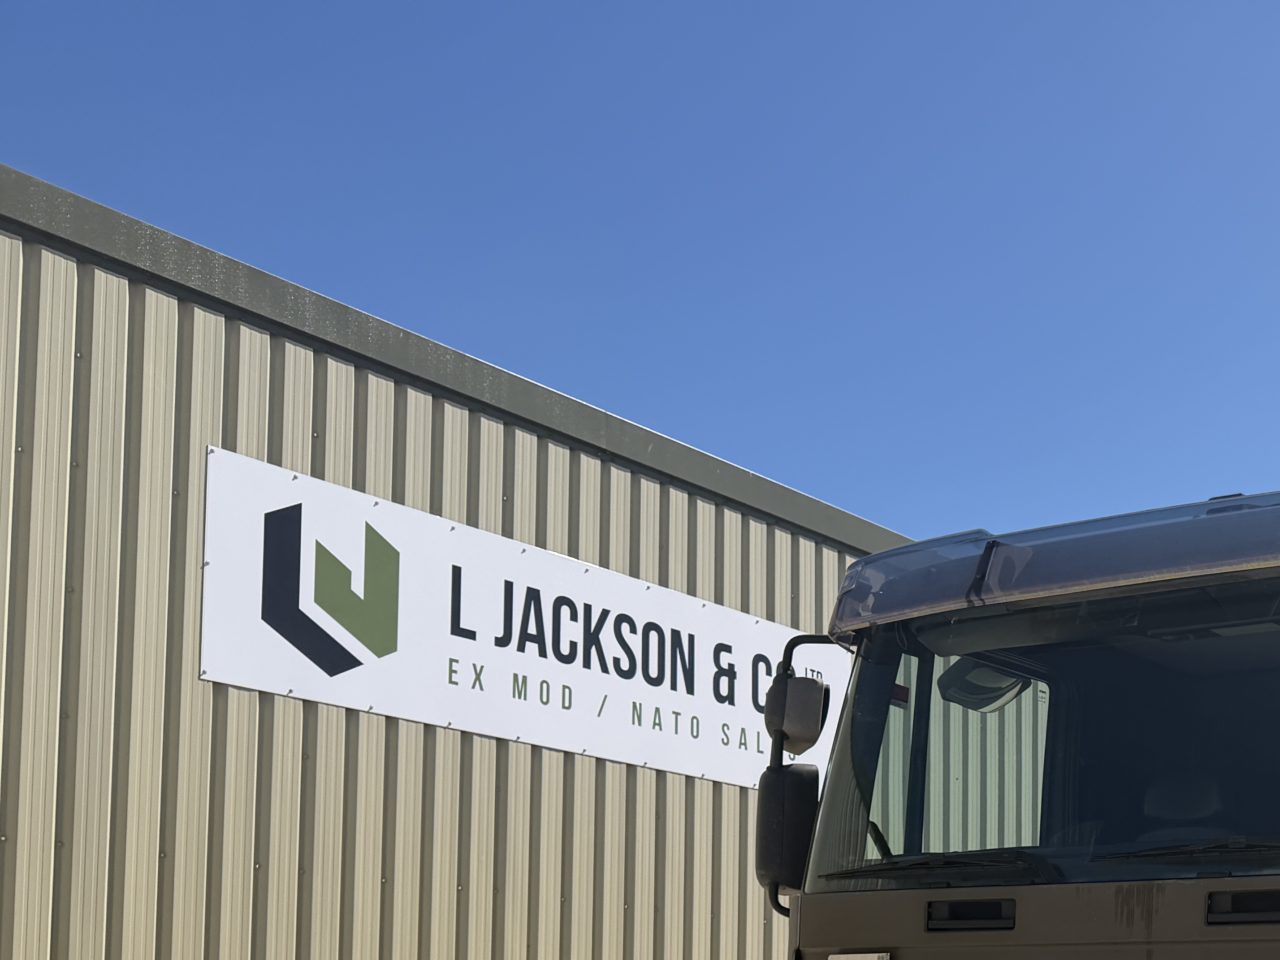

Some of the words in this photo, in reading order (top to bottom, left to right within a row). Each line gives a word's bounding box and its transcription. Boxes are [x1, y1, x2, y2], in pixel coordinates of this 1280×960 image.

[450, 565, 477, 641] L
[494, 580, 696, 696] JACKSON
[713, 643, 738, 706] &
[449, 658, 484, 691] EX
[513, 673, 573, 711] MOD
[597, 695, 608, 718] /
[632, 702, 700, 740] NATO
